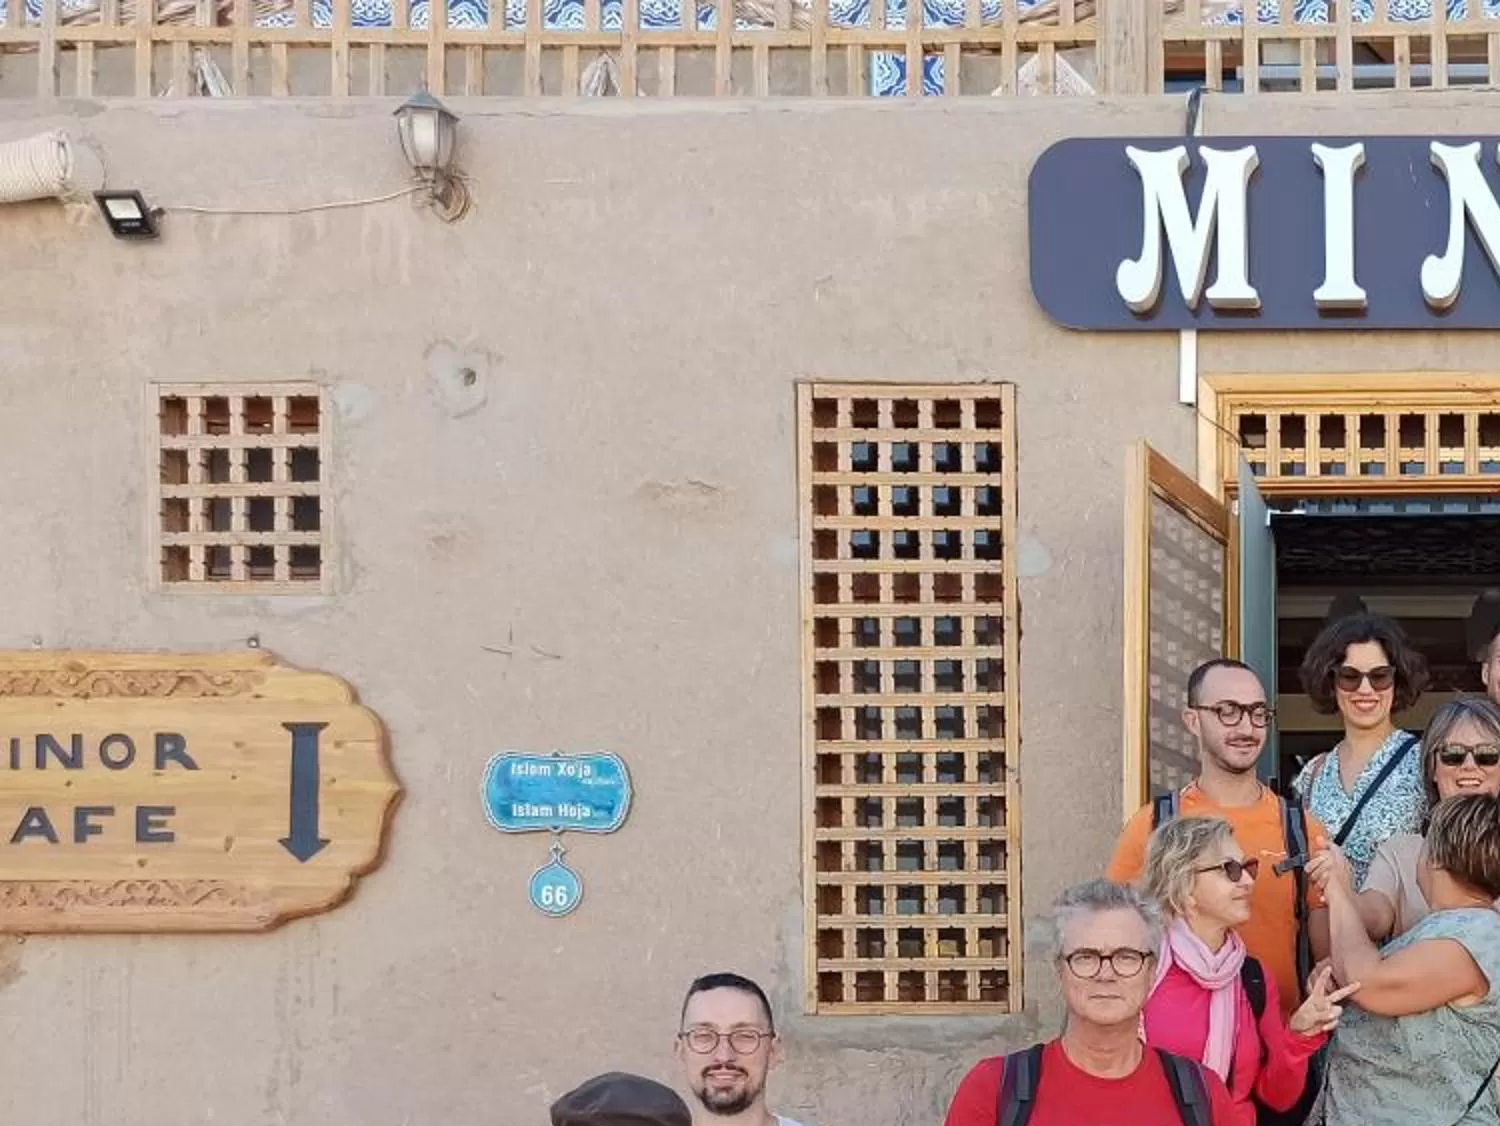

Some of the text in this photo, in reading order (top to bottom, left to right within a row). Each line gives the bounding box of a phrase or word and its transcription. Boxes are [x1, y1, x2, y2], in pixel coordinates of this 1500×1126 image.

[9, 732, 201, 770] INOR
[9, 805, 176, 843] AFE
[511, 803, 591, 821] Islam Hoja
[541, 885, 567, 905] 66
